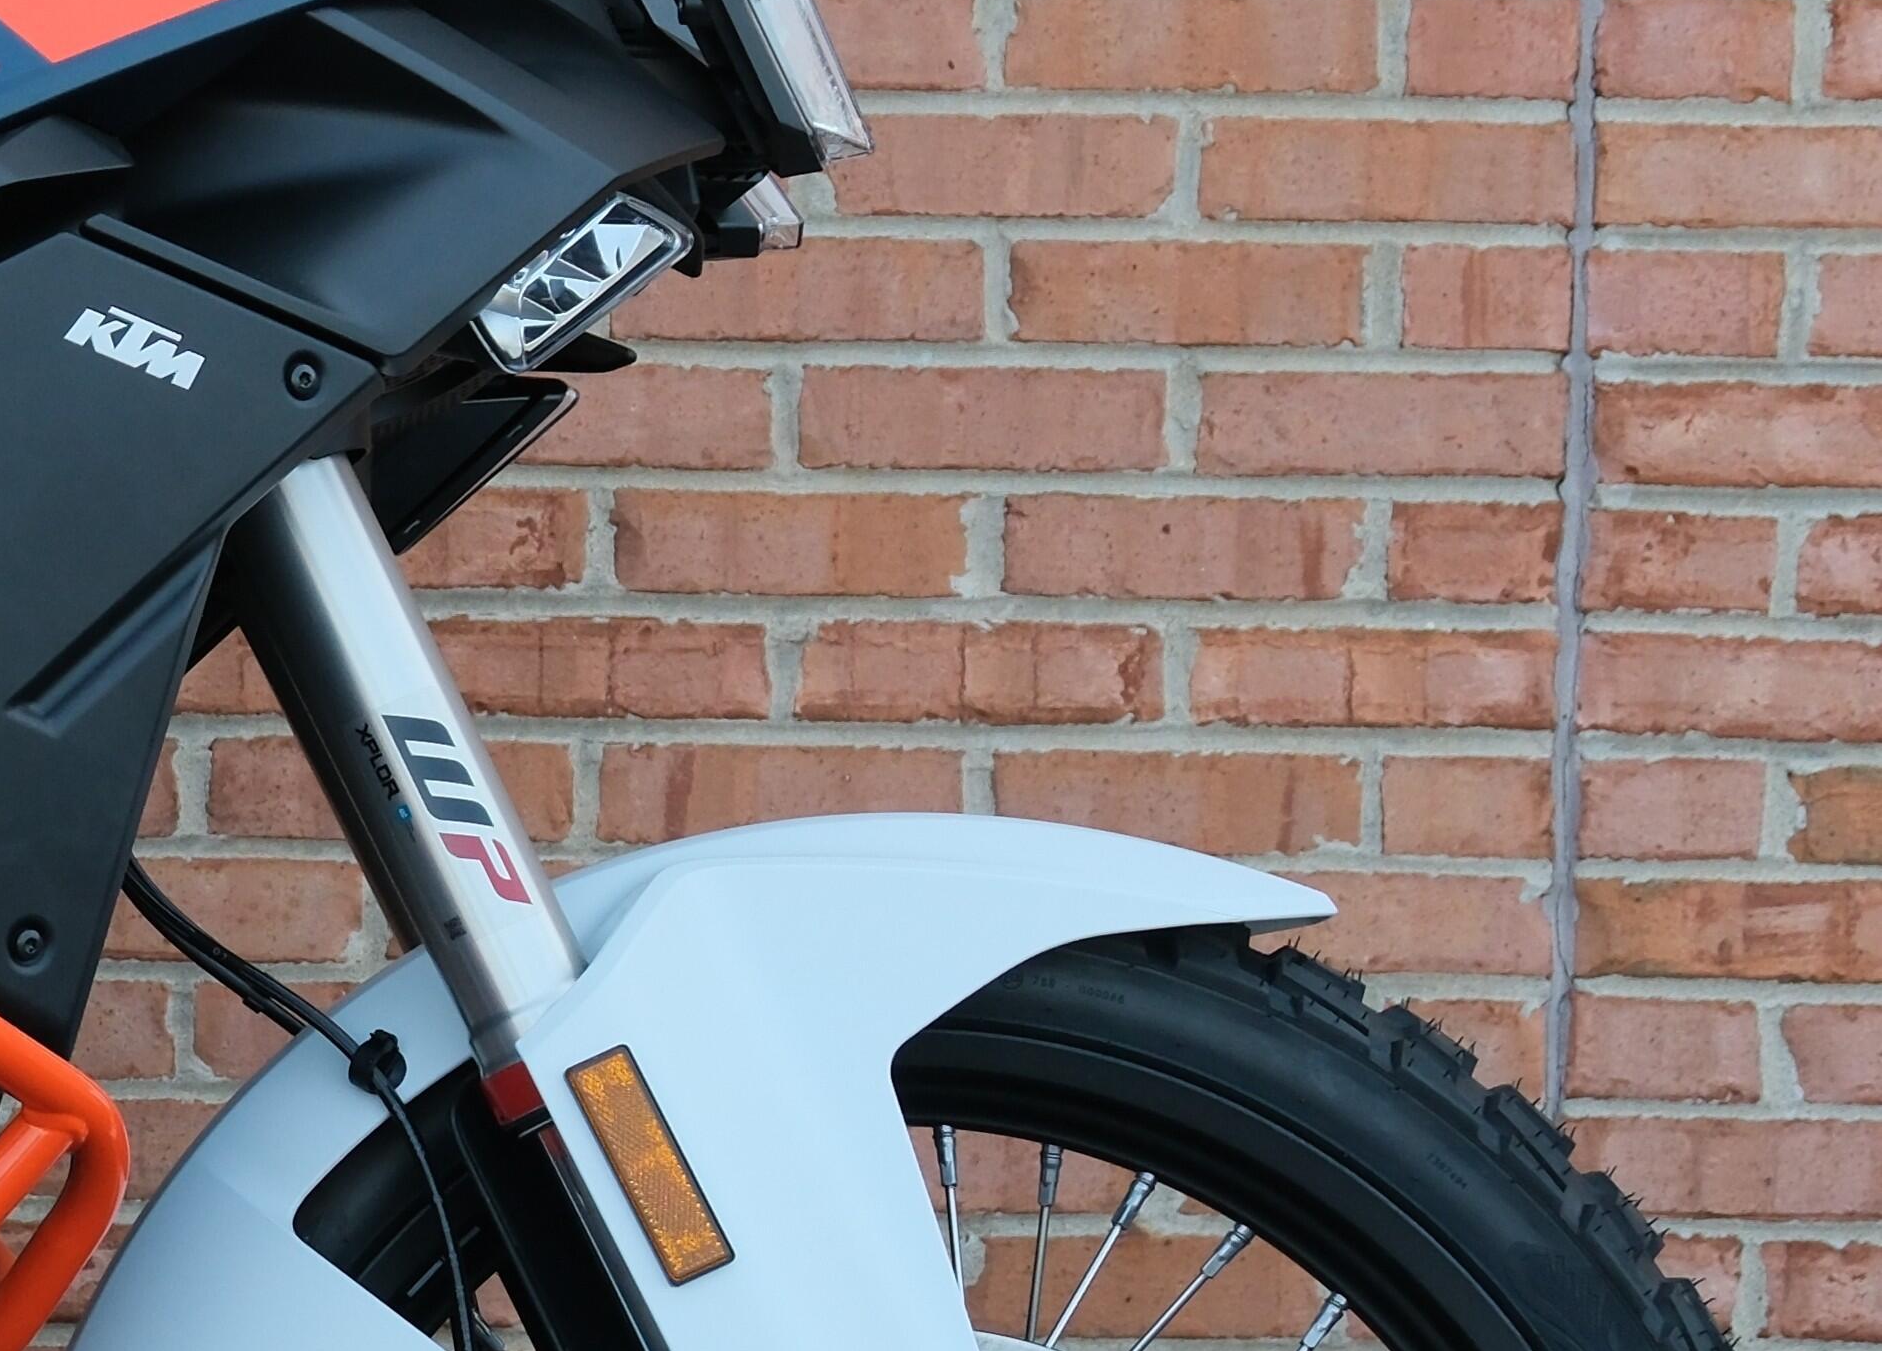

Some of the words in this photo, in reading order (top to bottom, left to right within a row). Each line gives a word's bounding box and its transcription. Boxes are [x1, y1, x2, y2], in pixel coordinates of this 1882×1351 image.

[63, 305, 206, 391] KTM
[356, 723, 400, 801] XPLOR
[381, 715, 533, 905] WP
